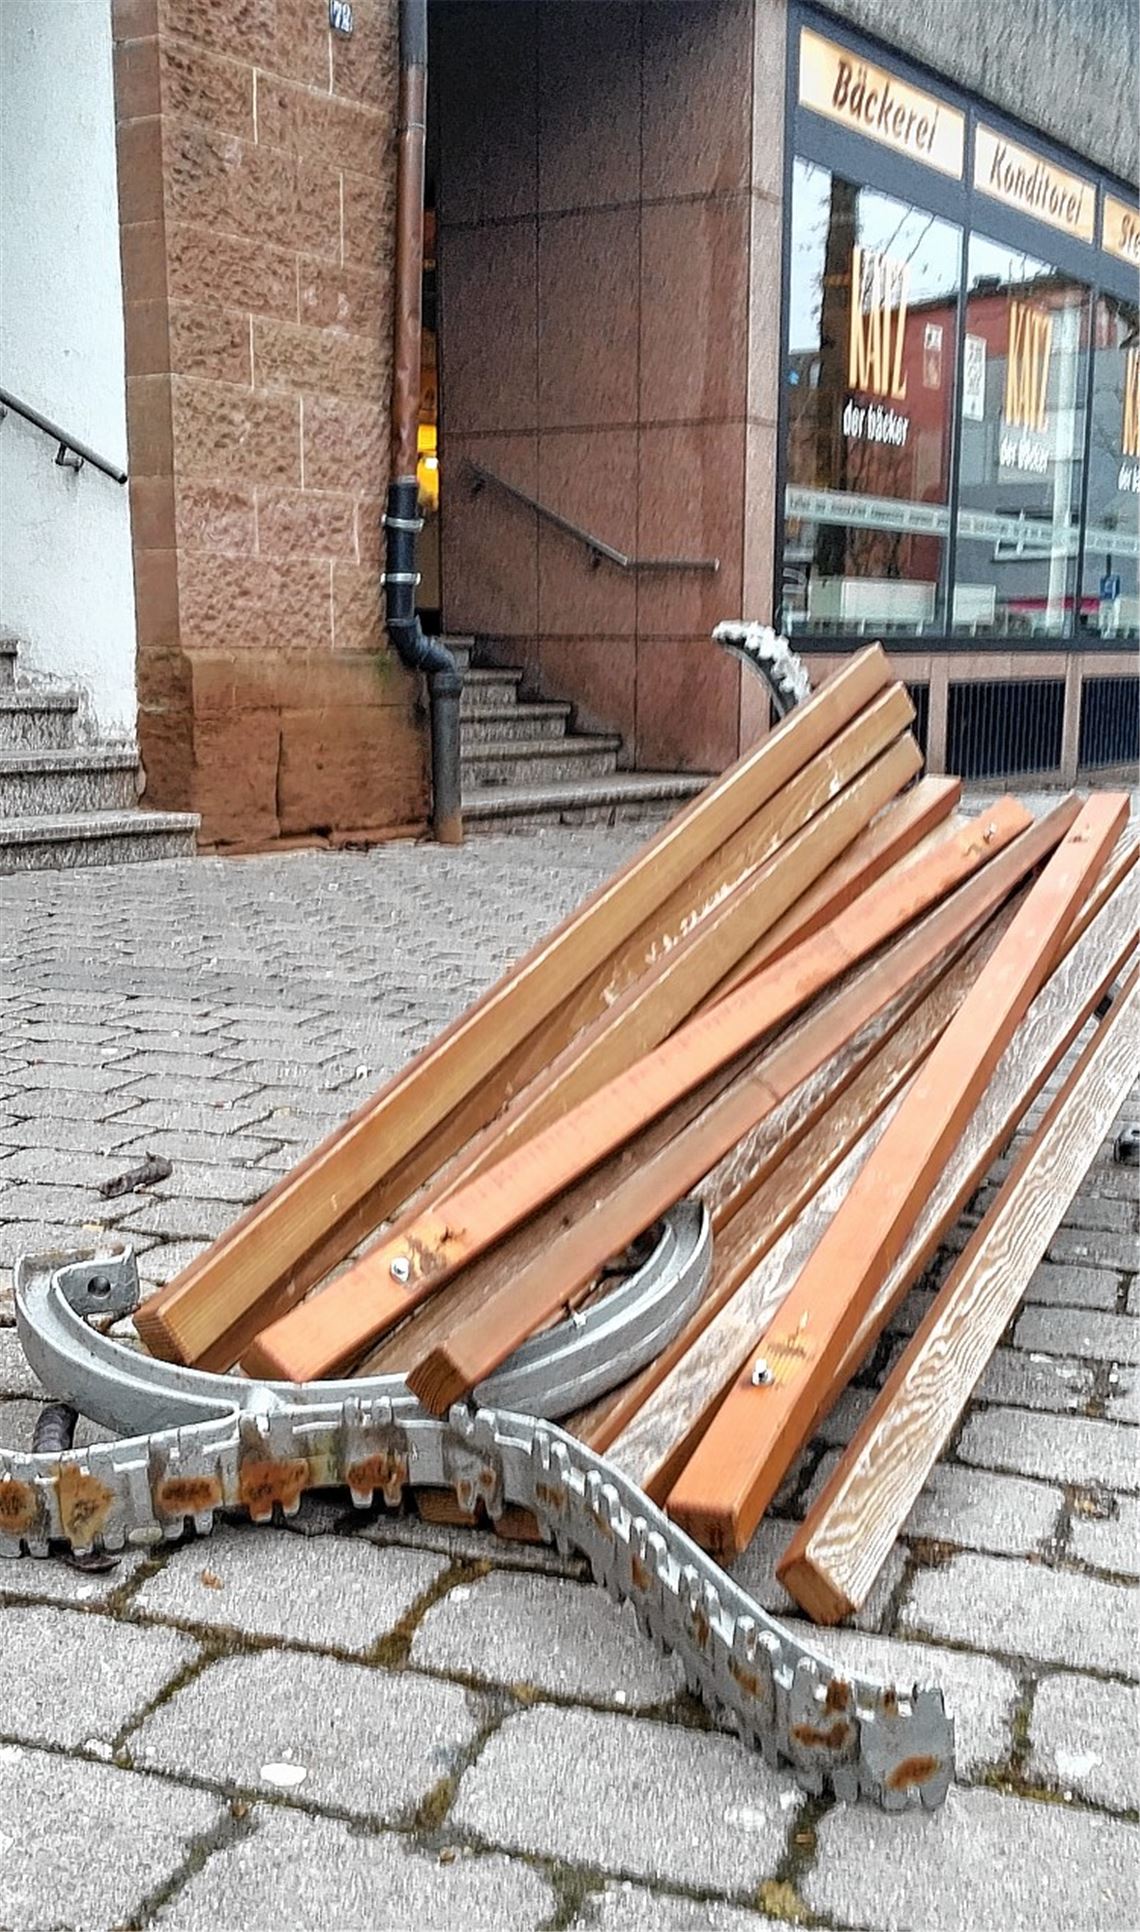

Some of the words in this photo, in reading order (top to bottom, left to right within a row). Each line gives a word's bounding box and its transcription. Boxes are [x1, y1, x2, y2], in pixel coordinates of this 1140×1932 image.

[832, 58, 939, 154] Bäckerei
[989, 141, 1085, 225] Konditorei
[849, 245, 911, 400] KATZ
[1005, 300, 1053, 433] KATZ
[843, 398, 866, 439] der
[867, 402, 910, 447] bäcker
